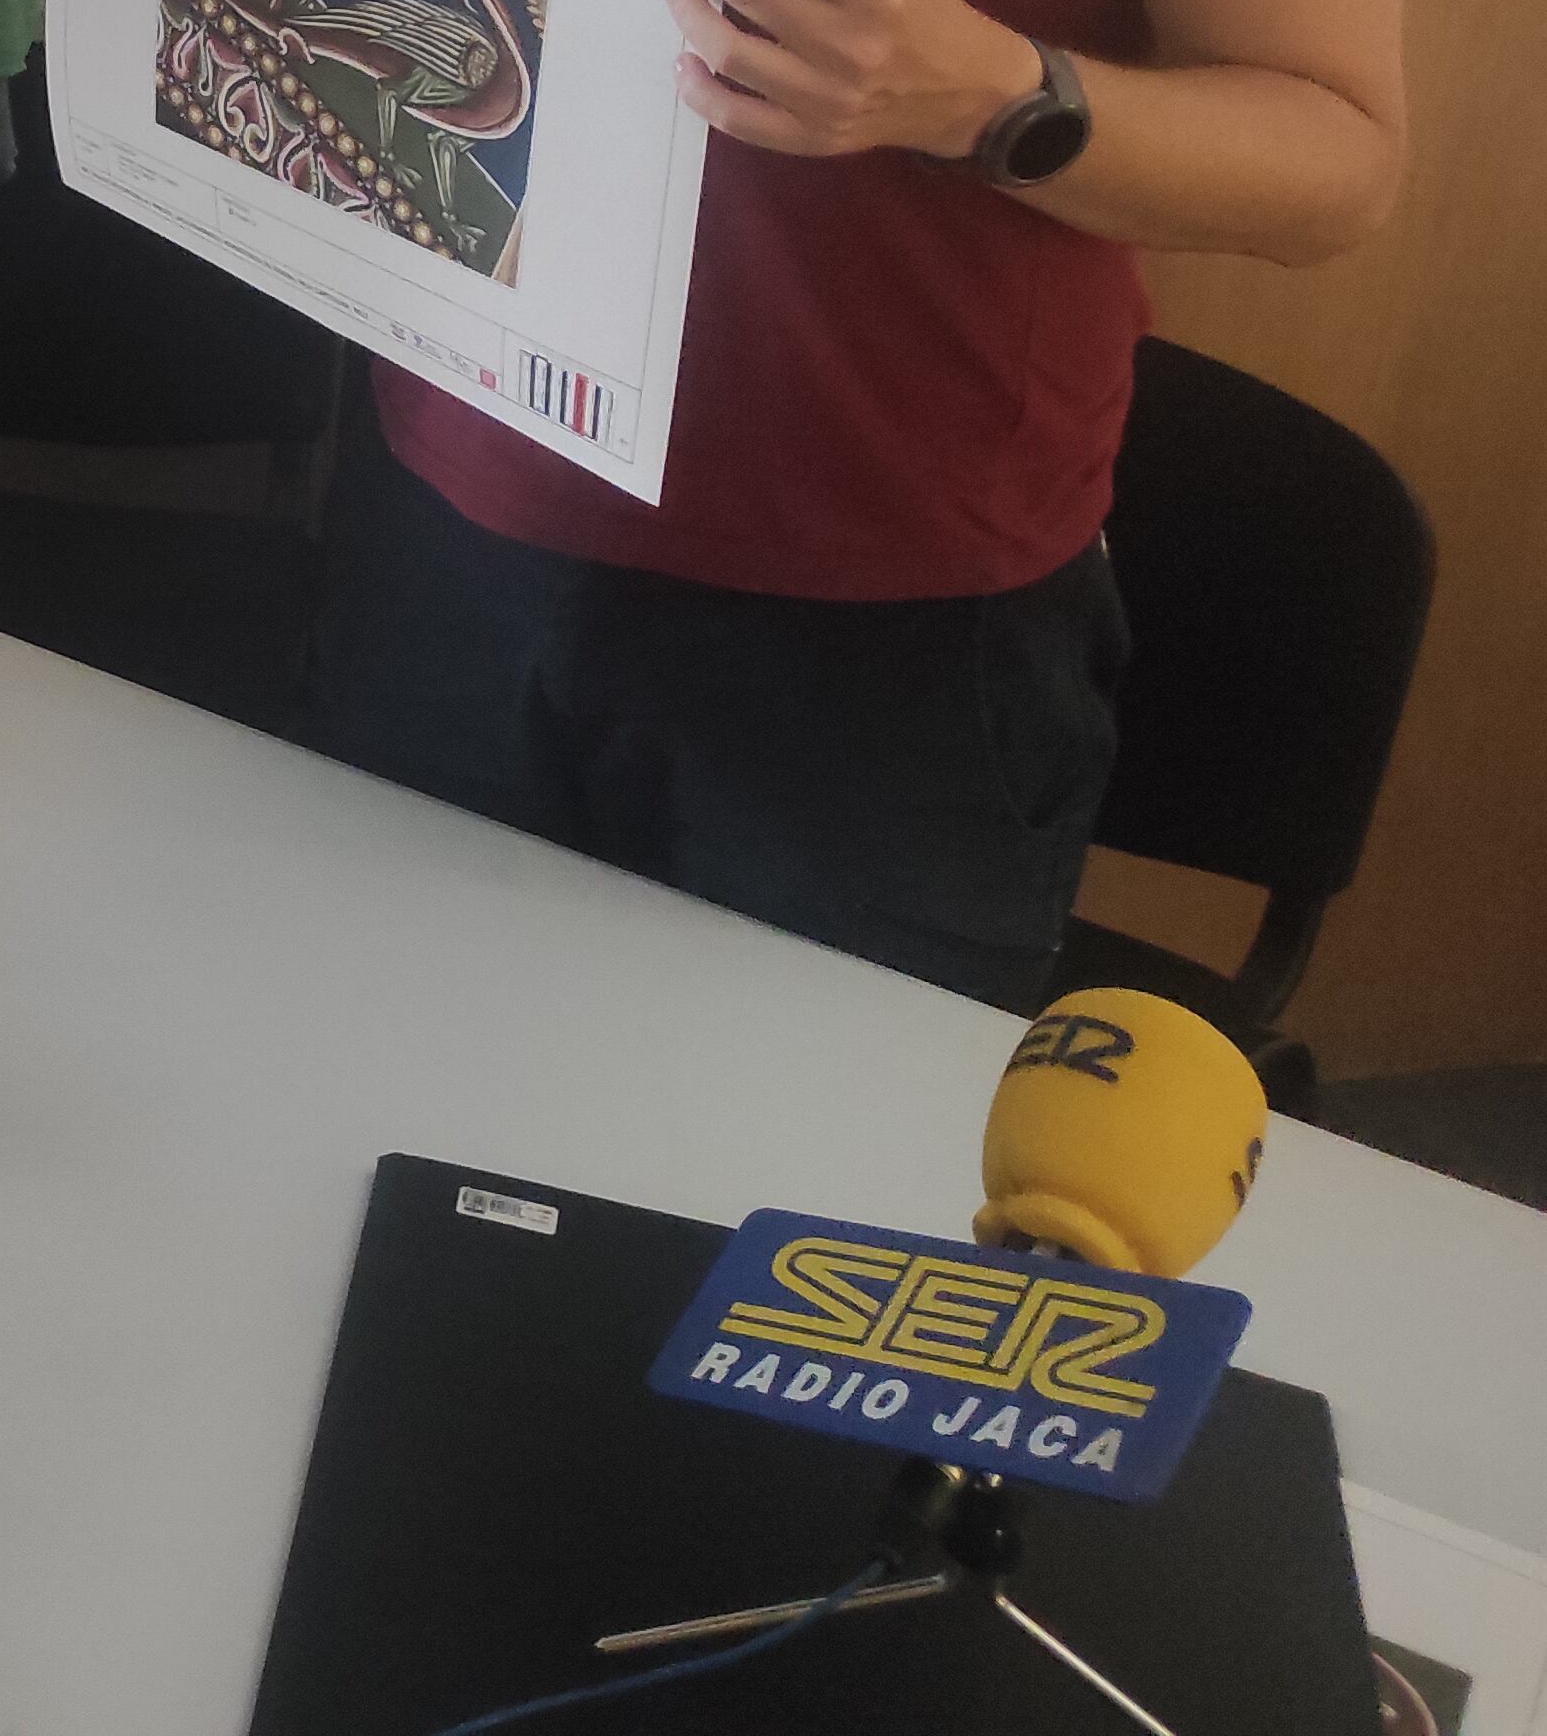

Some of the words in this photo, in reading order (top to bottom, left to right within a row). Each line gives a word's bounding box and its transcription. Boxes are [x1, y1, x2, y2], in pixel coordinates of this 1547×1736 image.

[1002, 1014, 1136, 1085] ER
[719, 1236, 1167, 1419] SER
[691, 1341, 910, 1421] RADIO
[932, 1397, 1124, 1473] JACA
